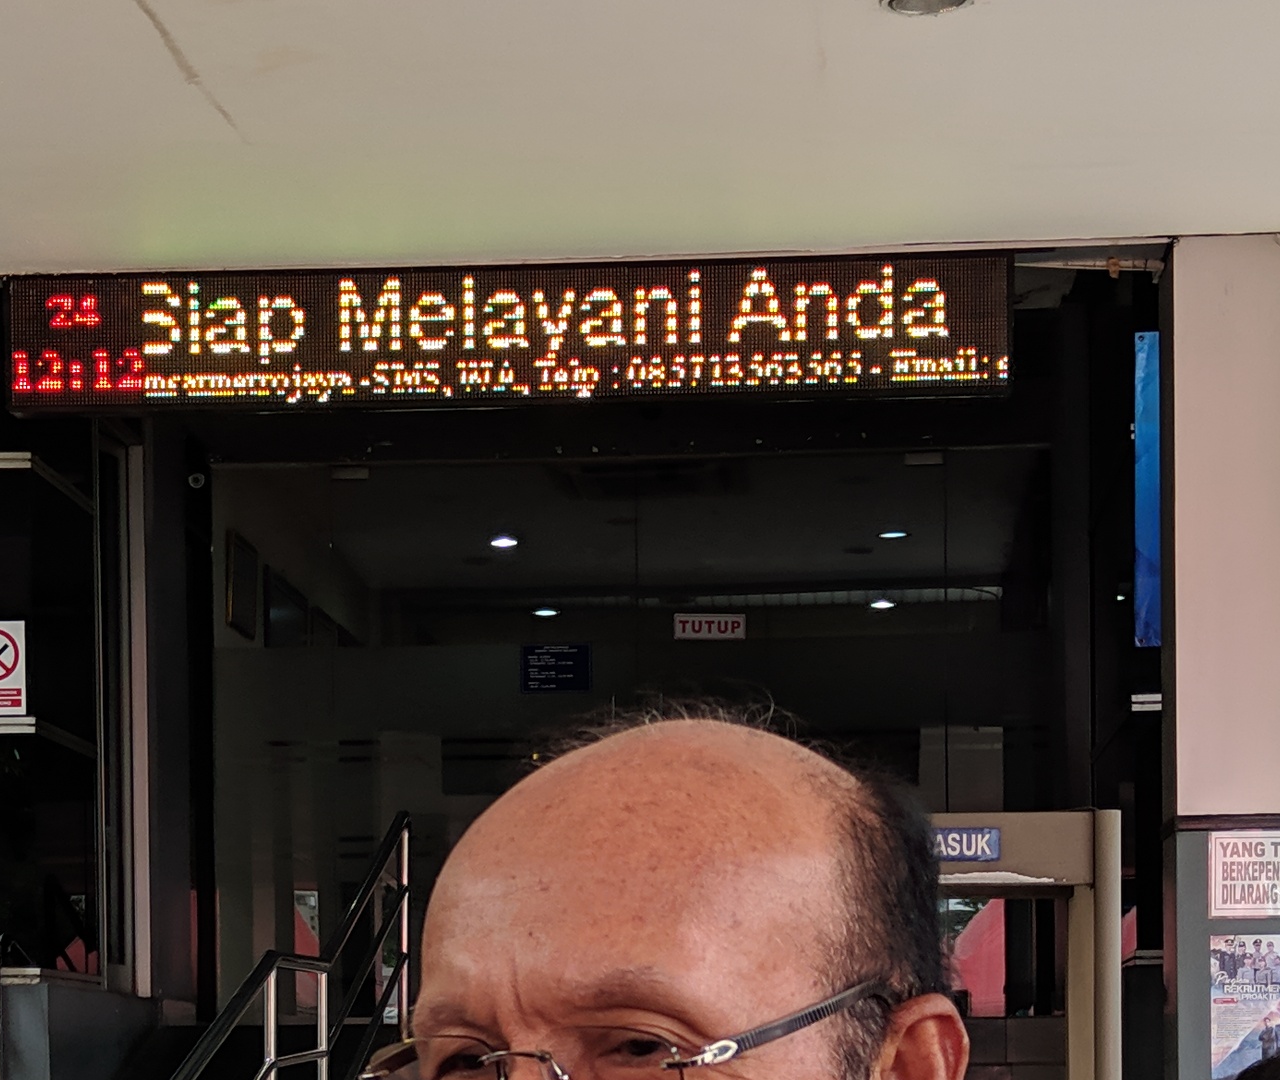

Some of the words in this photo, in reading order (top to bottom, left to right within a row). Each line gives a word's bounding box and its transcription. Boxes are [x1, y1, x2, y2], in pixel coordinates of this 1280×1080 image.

[338, 268, 701, 359] Melayani
[726, 262, 950, 344] Anda
[12, 348, 145, 393] 12:12
[678, 619, 742, 634] TUTUP
[933, 832, 993, 857] ASUK
[1219, 841, 1266, 858] YANG
[1221, 883, 1278, 905] DILARANG
